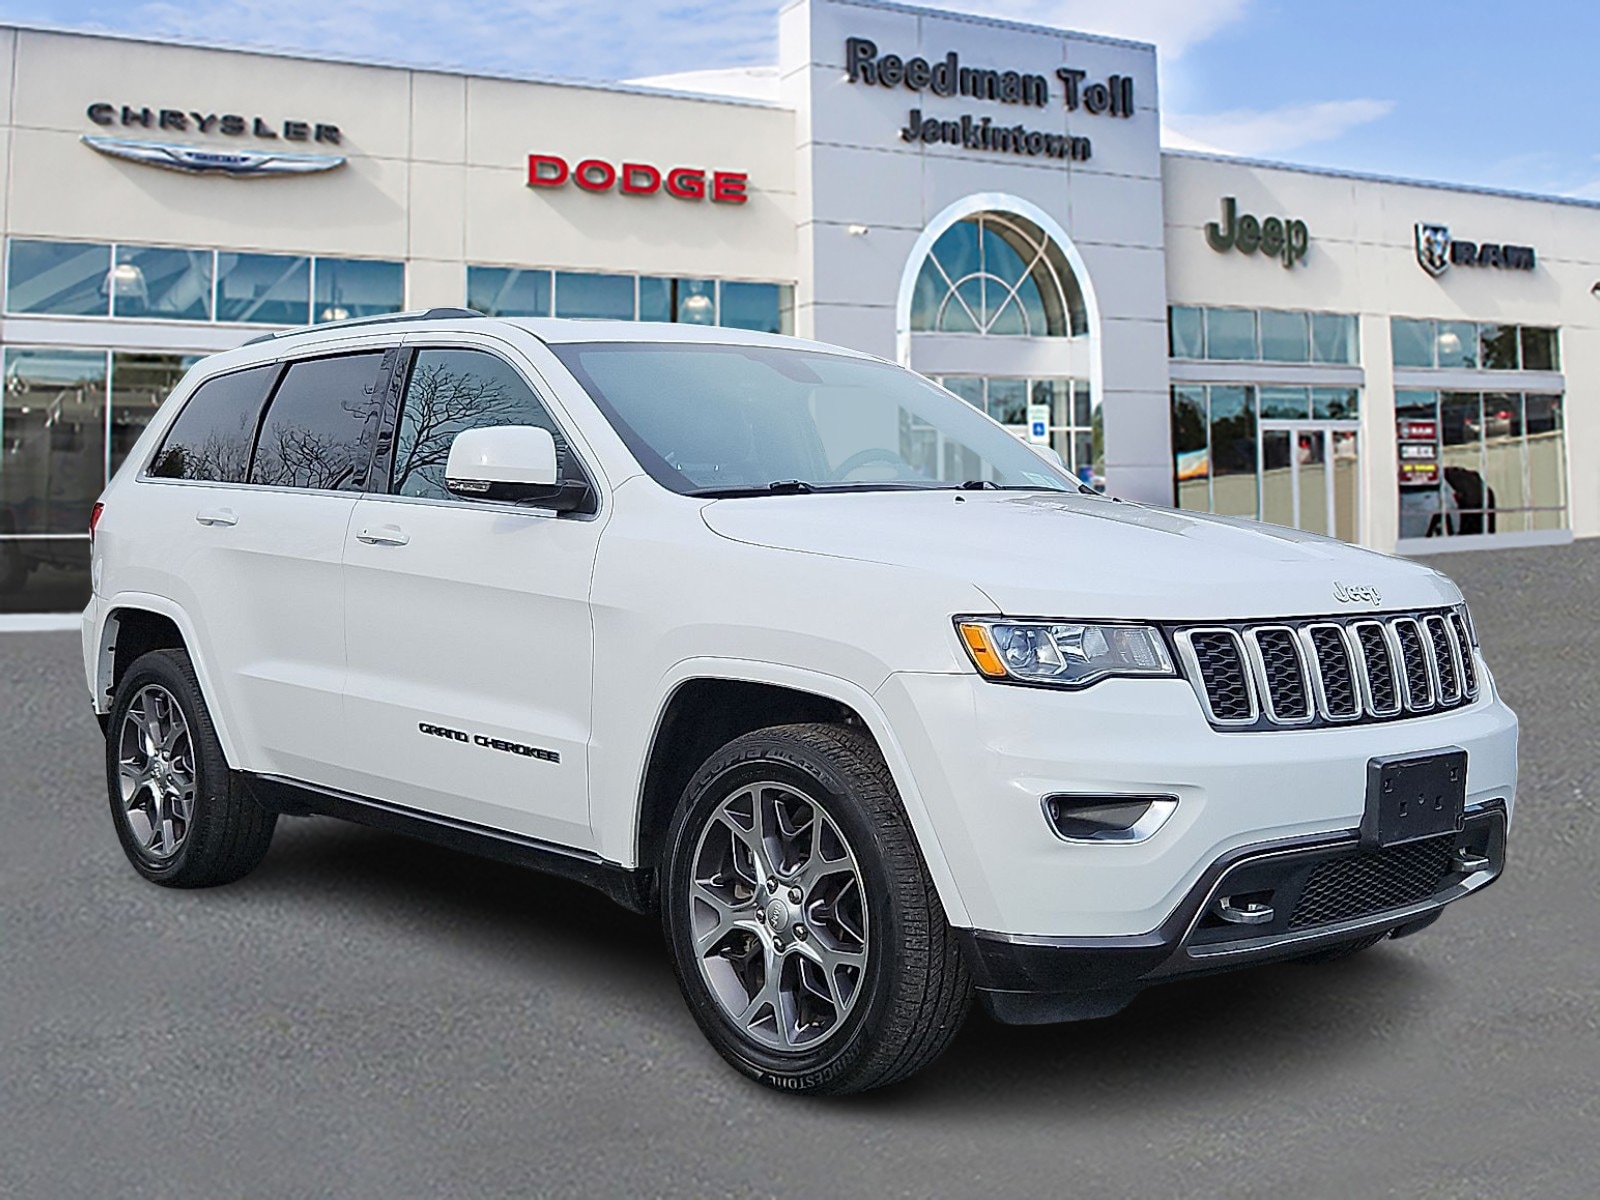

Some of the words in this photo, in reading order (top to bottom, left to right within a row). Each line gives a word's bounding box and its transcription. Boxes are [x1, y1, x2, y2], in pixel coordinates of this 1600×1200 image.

[846, 36, 1049, 108] Reedman
[1056, 67, 1135, 119] Toll
[86, 103, 341, 145] CHRYSLER
[901, 108, 1092, 161] Jenkintown
[527, 154, 748, 205] DODGE
[1205, 196, 1308, 269] Jeep
[1449, 239, 1536, 270] RAM
[1333, 579, 1381, 607] Jeep
[419, 723, 469, 743] GRAND
[474, 735, 560, 763] CHEROKEE
